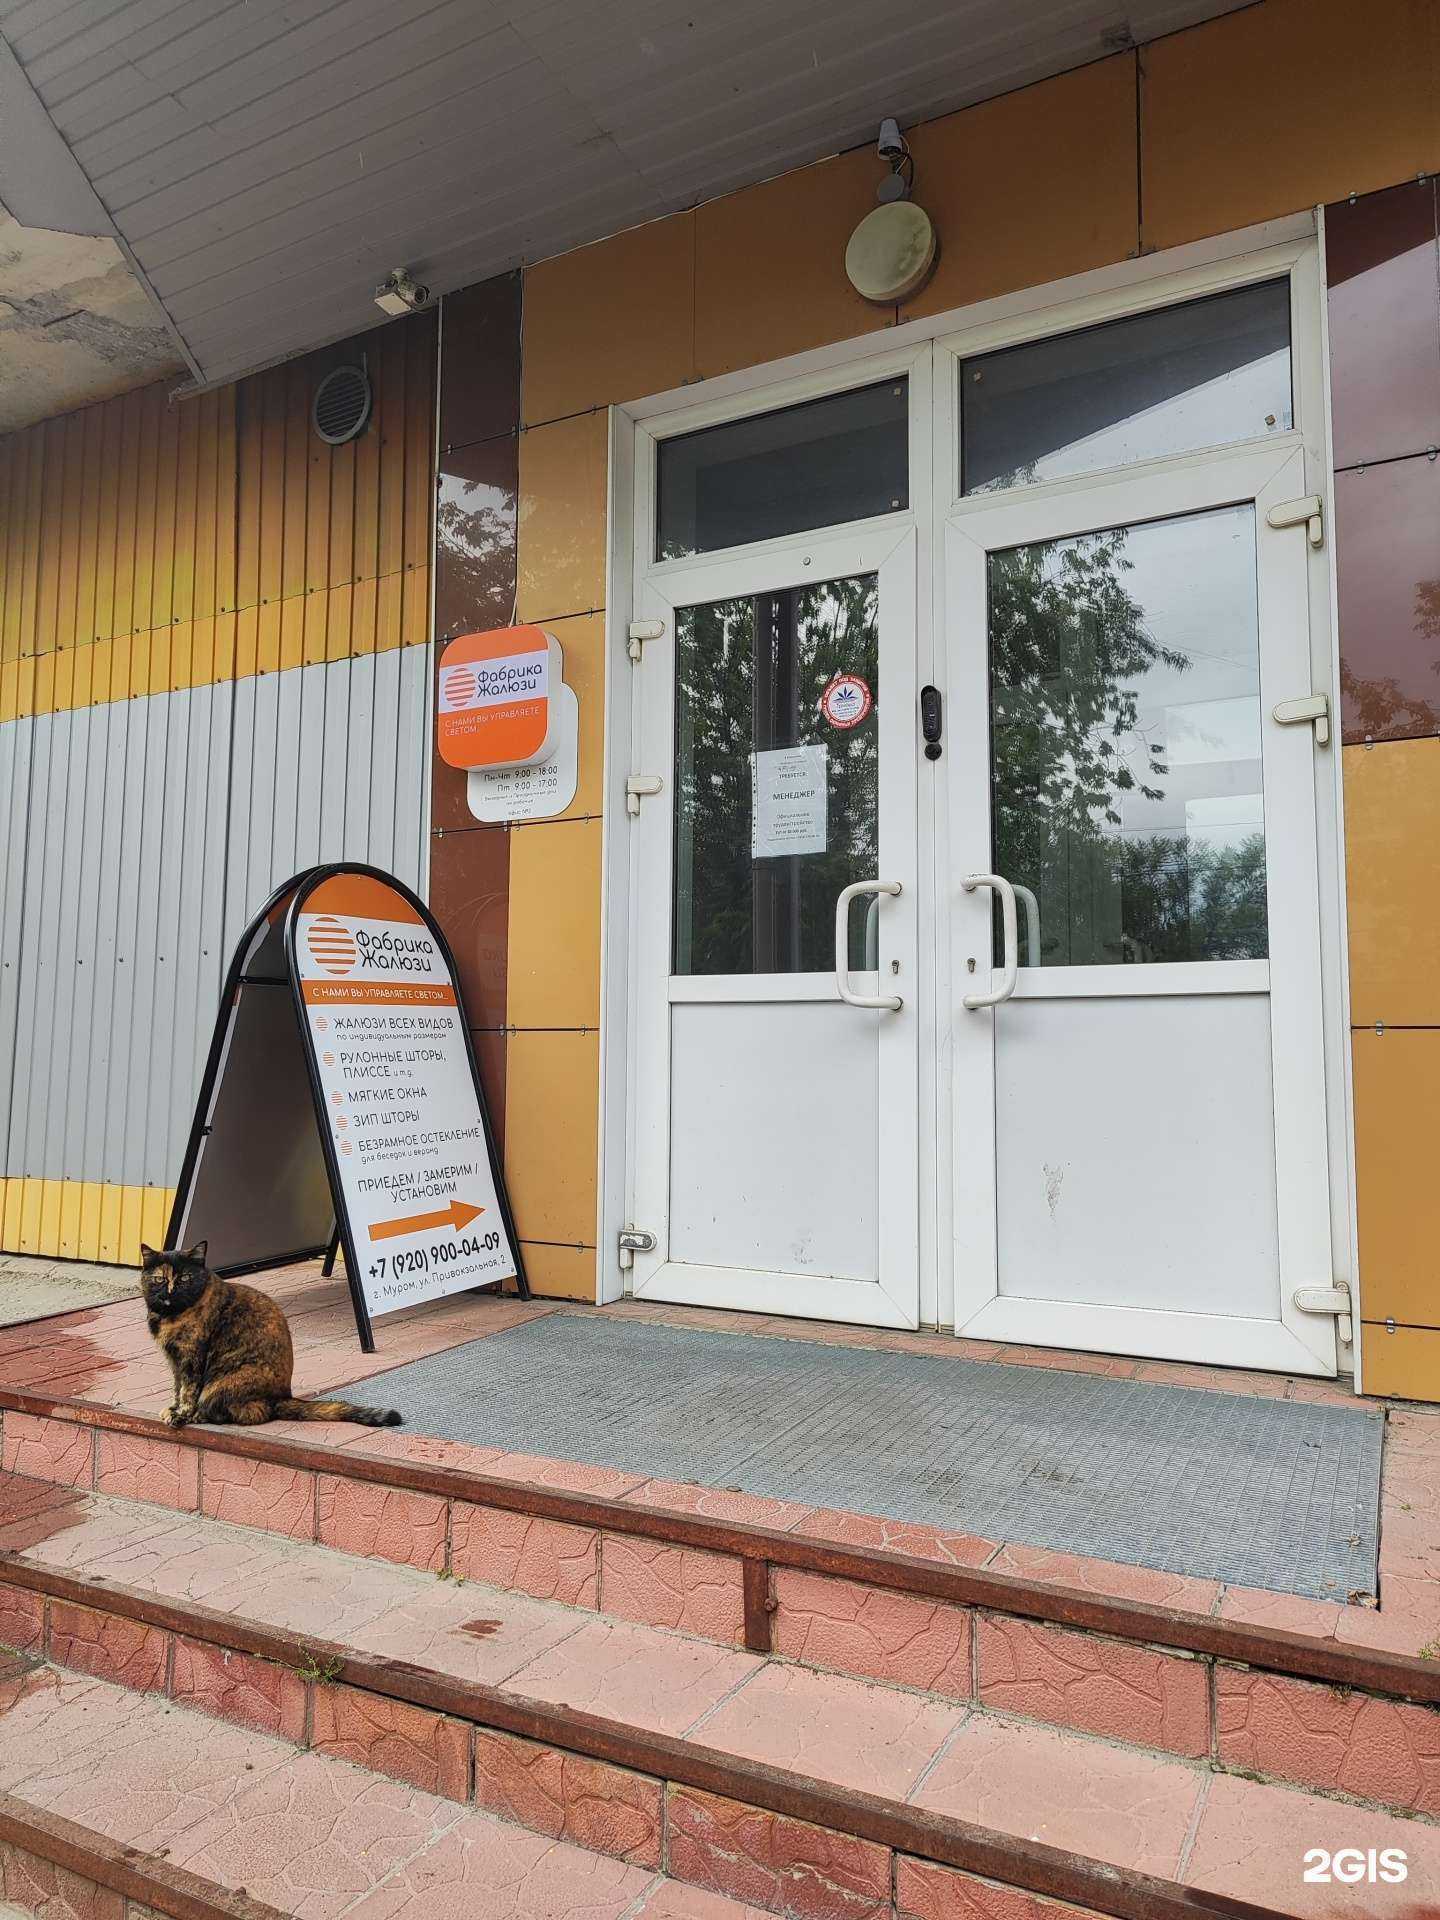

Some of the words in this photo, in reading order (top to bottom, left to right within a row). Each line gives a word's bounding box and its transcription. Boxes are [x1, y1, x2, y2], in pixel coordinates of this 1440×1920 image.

[478, 664, 543, 683] Фабрика
[477, 679, 537, 698] Жалюзи
[490, 706, 540, 721] УПРАВЛЯЕТЕ
[514, 769, 531, 778] 9:00
[538, 766, 558, 776] 18:00
[514, 781, 531, 791] 9:00
[538, 778, 558, 788] 17:00
[772, 789, 815, 801] МЕНЕДЖЕР
[355, 929, 434, 955] Фабрика
[358, 948, 432, 972] Жалюзи
[312, 988, 320, 997] С
[321, 988, 350, 998] НАМИ
[351, 989, 363, 998] ВЫ
[364, 989, 413, 999] УПРАВЛЯЕТЕ
[333, 1017, 387, 1029] ЖАЛЮЗИ
[389, 1017, 416, 1029] ВСЕХ
[419, 1017, 454, 1030] ВИДОВ
[349, 1033, 412, 1042] индивидуальным
[340, 1050, 402, 1064] РУЛОННЫЕ
[405, 1049, 447, 1061] ШТОРЫ,
[343, 1065, 391, 1079] ПЛИССЕ
[347, 1088, 396, 1102] МЯГКИЕ
[397, 1086, 428, 1100] ОКНА
[352, 1113, 379, 1127] ЗИП
[381, 1110, 421, 1125] ШТОРЫ
[358, 1134, 419, 1152] БЕЗРАМНОЕ
[420, 1127, 480, 1144] ОСТЕКЛЕНИЕ
[361, 1155, 374, 1165] для
[376, 1150, 408, 1161] беседок
[413, 1147, 439, 1156] веранд
[357, 1173, 415, 1192] ПРИЕДЕМ
[423, 1164, 474, 1182] ЗАМЕРИМ
[391, 1181, 458, 1203] УСТАНОВИМ
[369, 1258, 387, 1279] +7
[392, 1249, 429, 1280] (920)
[430, 1231, 500, 1265] 900-04-09
[373, 1291, 381, 1299] г.
[383, 1281, 418, 1297] Муром,
[419, 1275, 430, 1290] ул.
[432, 1259, 500, 1286] Привокзальная,
[500, 1255, 506, 1264] 2
